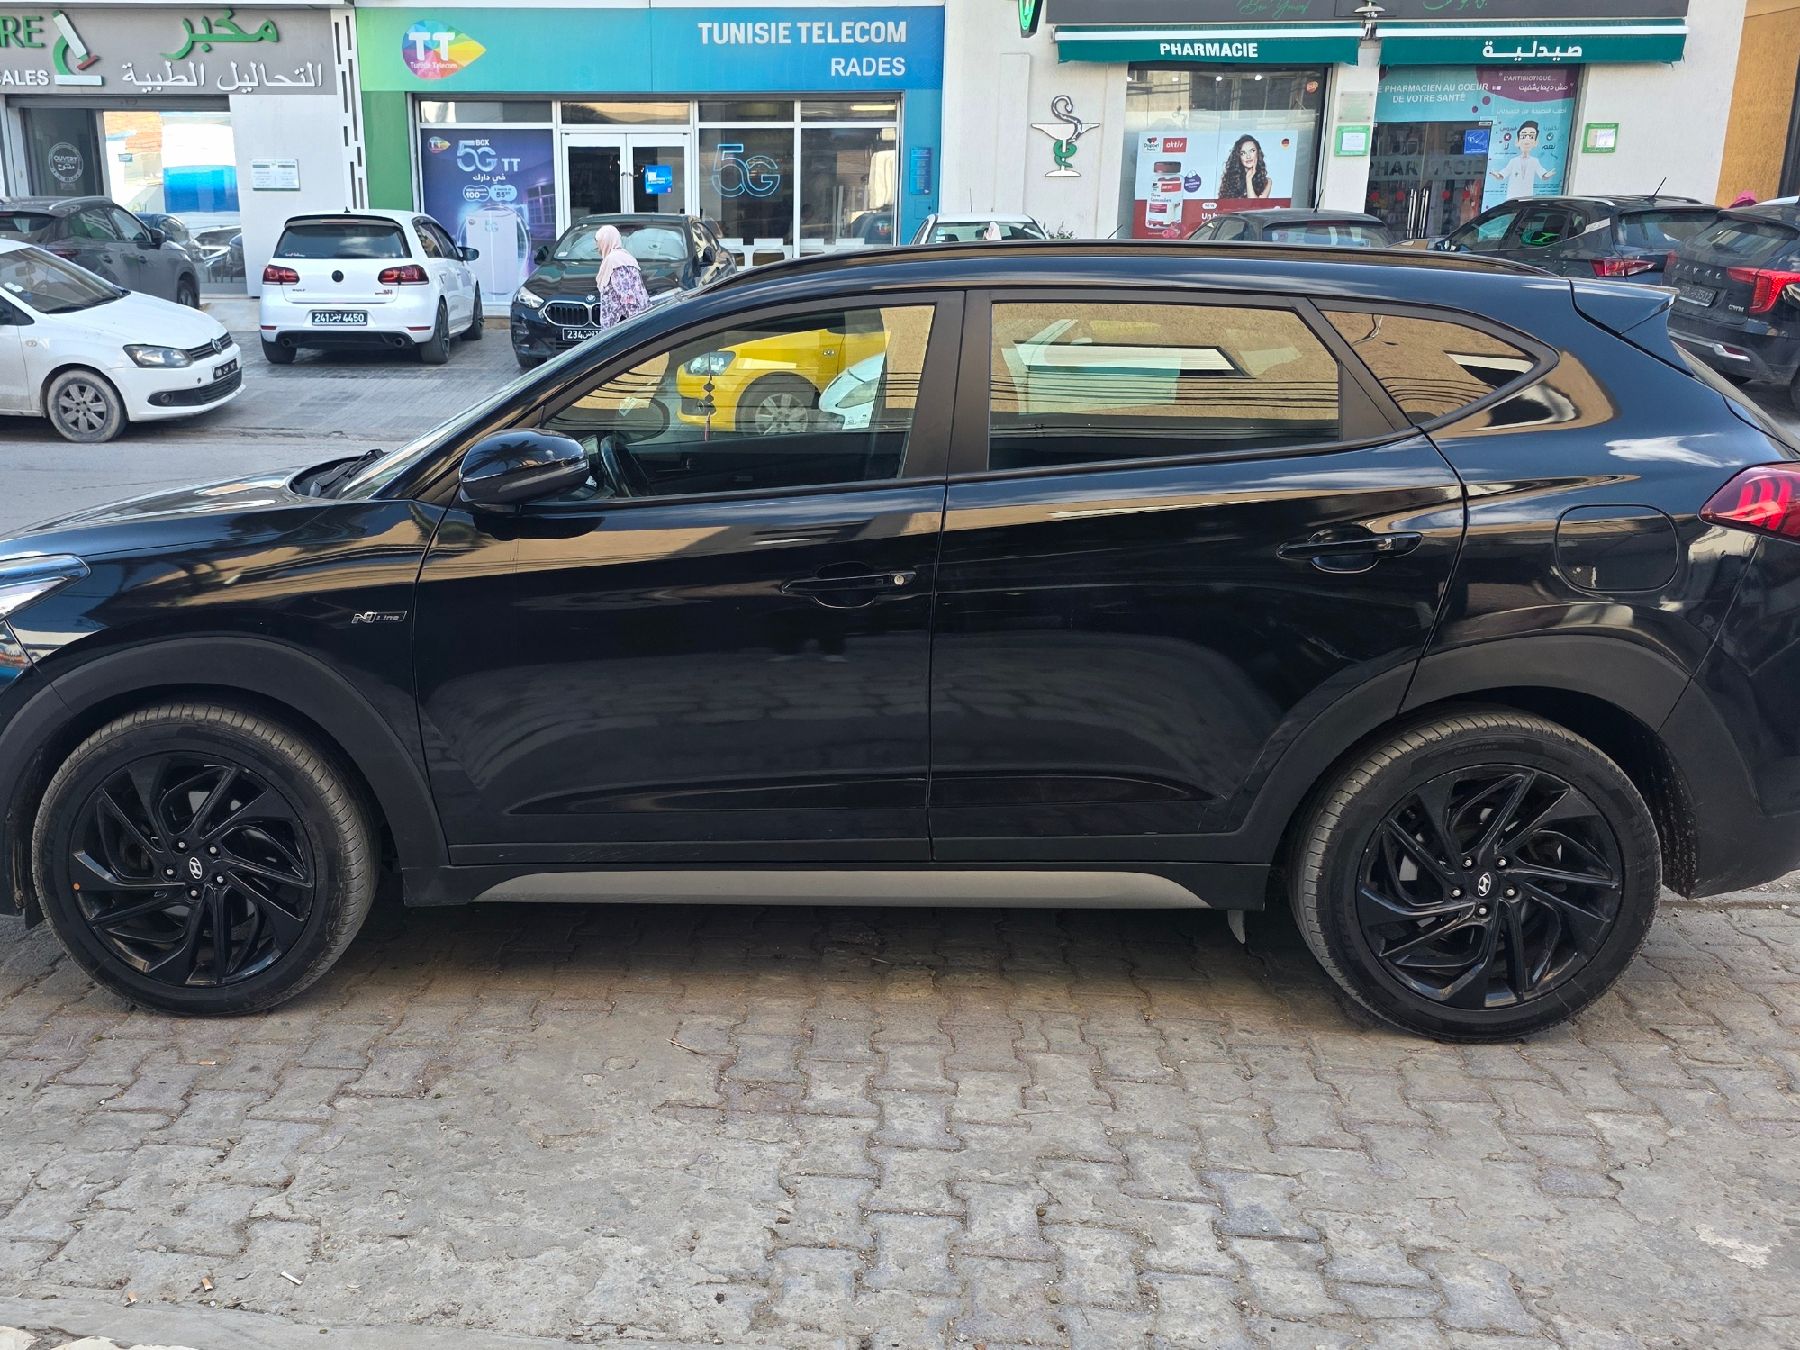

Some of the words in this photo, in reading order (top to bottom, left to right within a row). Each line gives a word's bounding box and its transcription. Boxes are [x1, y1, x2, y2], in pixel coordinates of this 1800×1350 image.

[160, 8, 279, 59] مخبر
[698, 22, 792, 44] TUNISIE
[797, 21, 907, 43] TELECOM
[408, 31, 456, 61] TT
[1160, 42, 1259, 58] PHARMACIE
[1482, 40, 1583, 61] صيدلية
[0, 69, 50, 86] ALES
[122, 61, 205, 94] الطبية
[216, 61, 322, 94] التحاليل
[830, 57, 906, 77] RADES
[1385, 84, 1441, 92] PHARMACIEN
[1443, 83, 1455, 92] AU
[1457, 83, 1489, 91] COEUR
[1392, 95, 1405, 104] DE
[1406, 94, 1435, 103] VOTRE
[1436, 93, 1466, 102] SANTÉ
[457, 139, 498, 172] 5G
[501, 158, 521, 172] TT
[711, 144, 780, 197] 5G
[342, 313, 365, 322] 4450
[567, 330, 582, 339] 234
